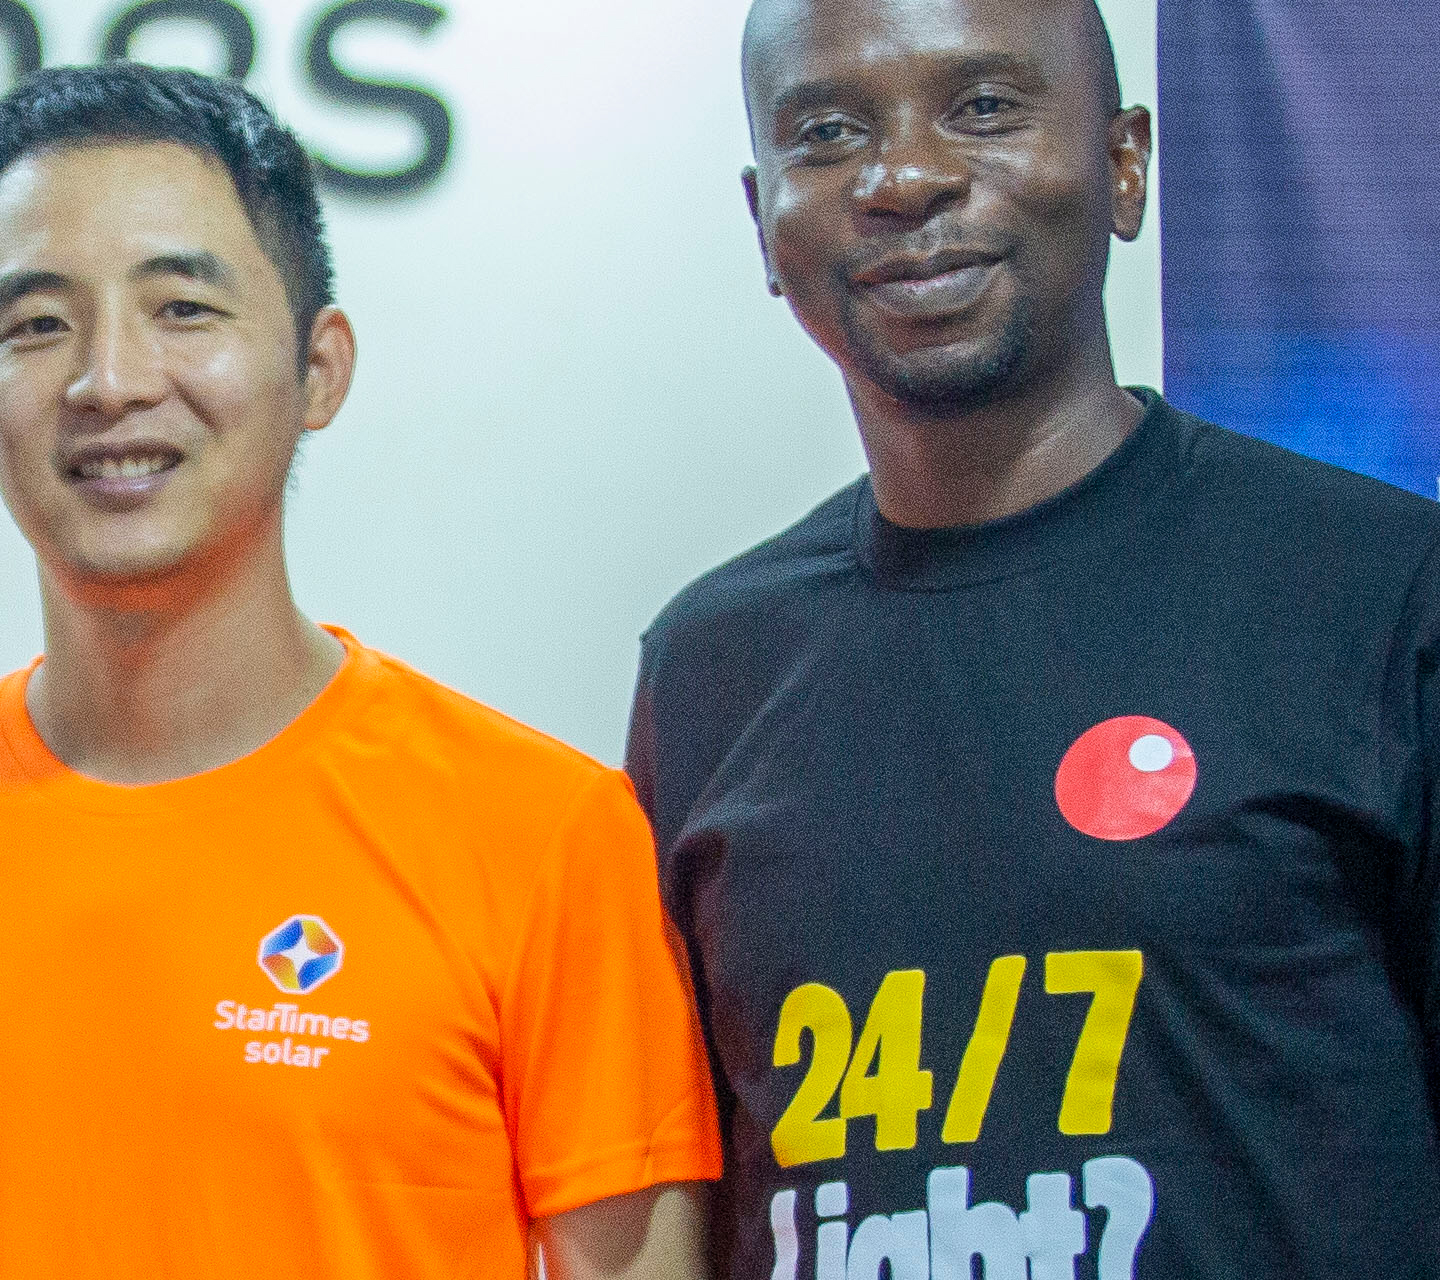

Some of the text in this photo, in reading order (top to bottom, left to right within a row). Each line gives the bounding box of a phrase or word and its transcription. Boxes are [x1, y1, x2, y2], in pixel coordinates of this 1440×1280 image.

[213, 999, 371, 1043] StarTimes
[243, 1037, 331, 1068] solar
[771, 949, 1145, 1169] 24/7
